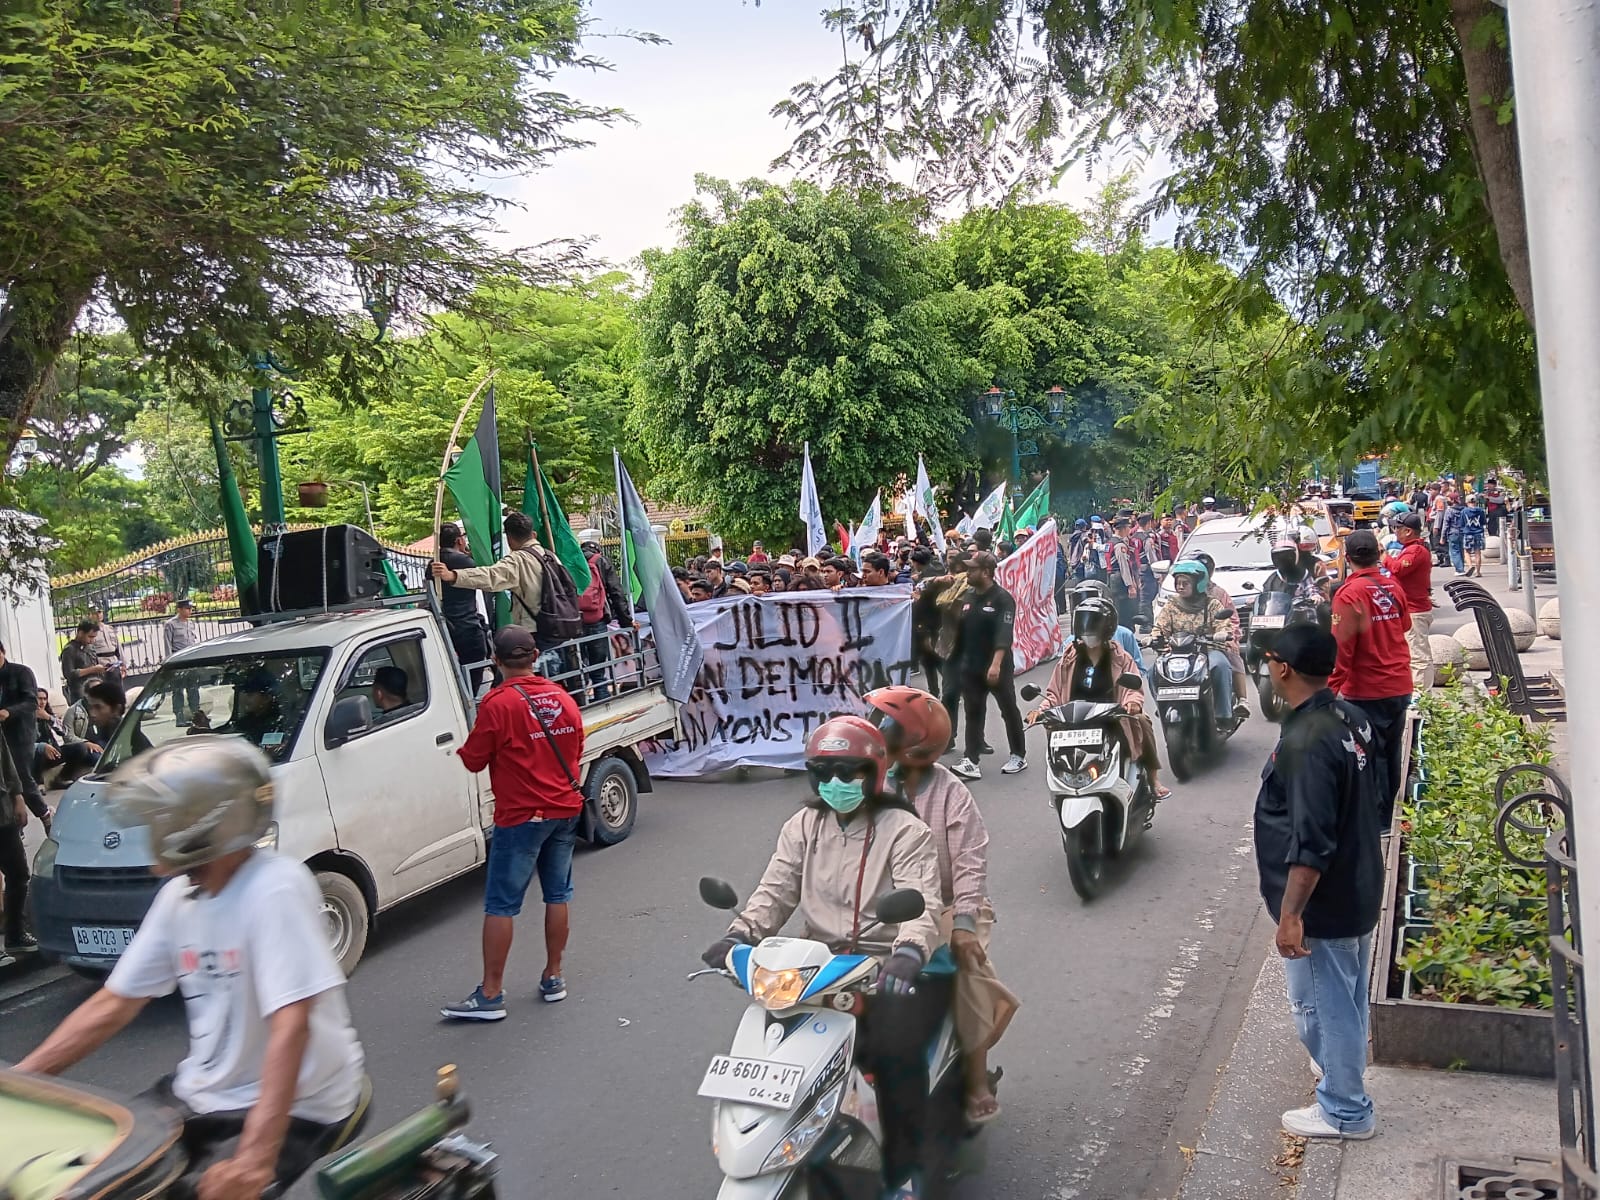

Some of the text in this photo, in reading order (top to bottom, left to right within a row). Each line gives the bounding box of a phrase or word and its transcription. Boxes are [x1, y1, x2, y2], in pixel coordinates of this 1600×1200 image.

[713, 601, 823, 650] JILID
[77, 929, 89, 945] AB
[92, 929, 117, 946] 8723
[709, 1059, 801, 1086] AB 6601 VT
